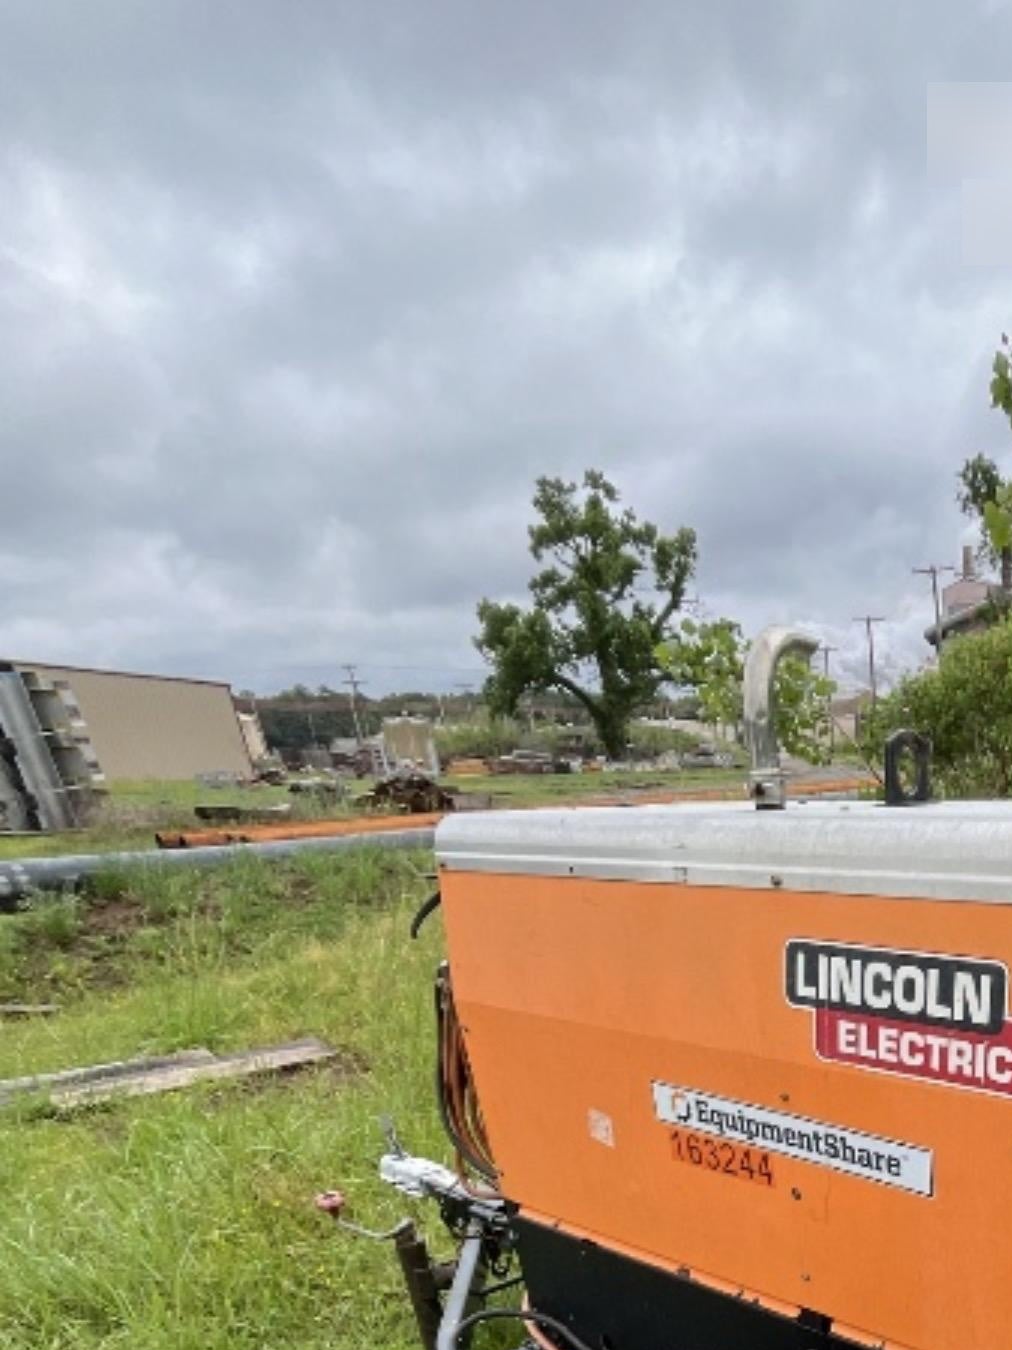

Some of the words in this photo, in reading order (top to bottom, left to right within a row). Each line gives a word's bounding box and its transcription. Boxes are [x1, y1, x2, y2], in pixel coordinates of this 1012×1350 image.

[796, 952, 992, 1025] LINCOLN
[670, 1130, 773, 1186] 163244
[696, 1099, 902, 1178] EquipmentShare
